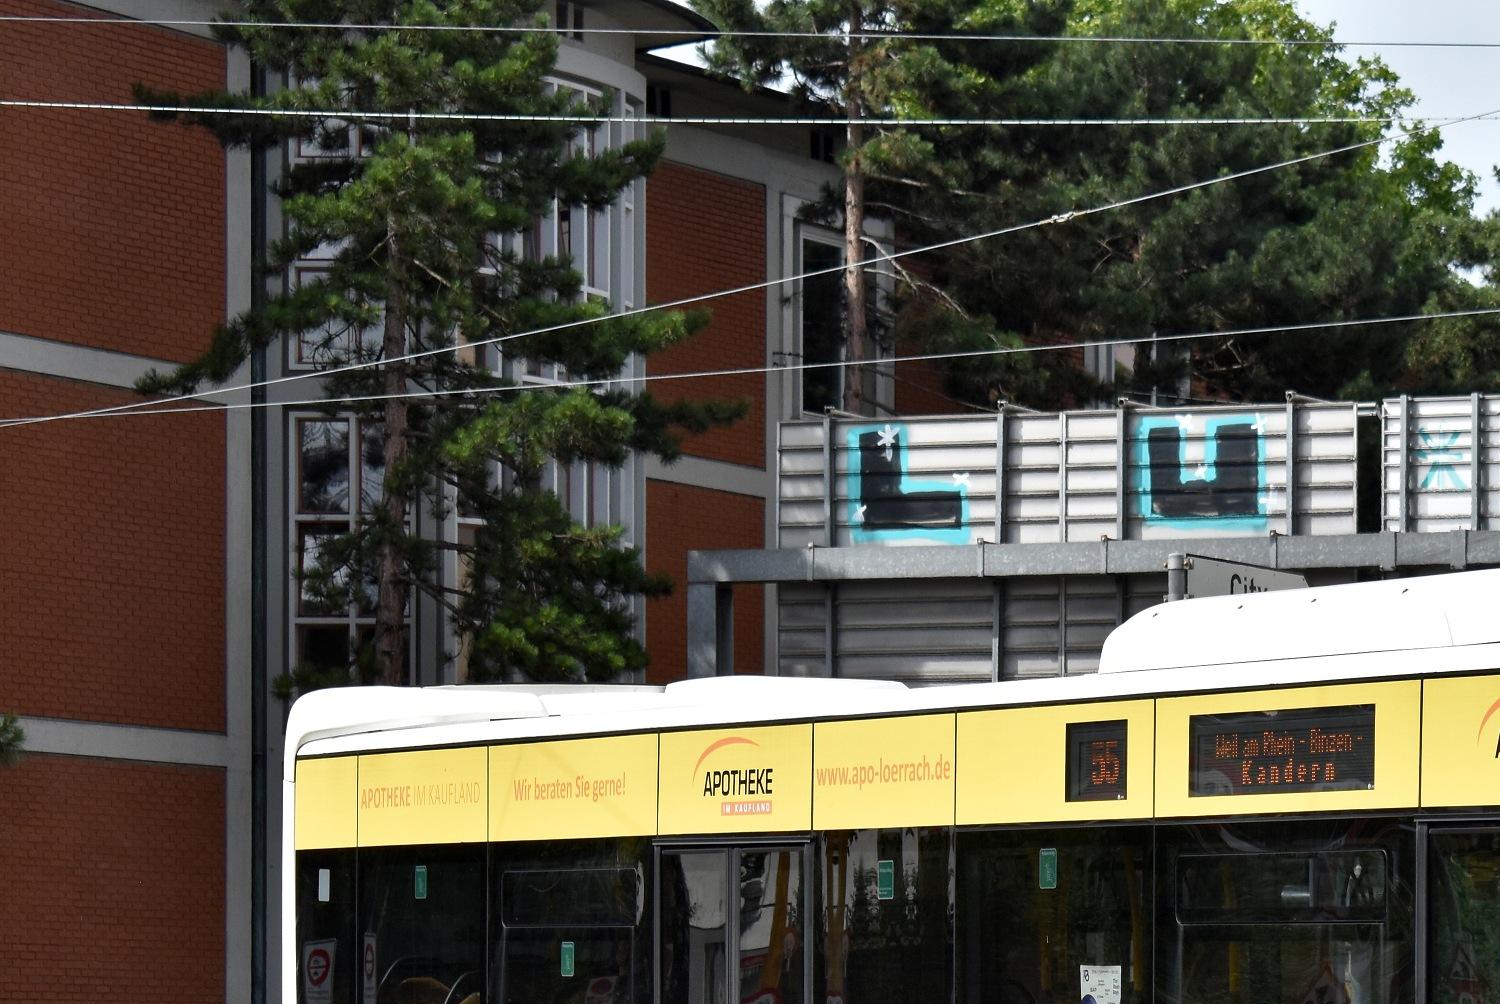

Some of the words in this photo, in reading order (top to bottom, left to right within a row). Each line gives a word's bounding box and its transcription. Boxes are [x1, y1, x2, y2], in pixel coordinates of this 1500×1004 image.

[1230, 574, 1268, 595] Cit
[1264, 730, 1294, 756] Rhein
[703, 768, 774, 797] APOTHEKE
[816, 754, 951, 791] www.apo-loerrach.de
[1242, 758, 1335, 785] Kandern
[361, 784, 412, 809] APOTHEKE
[413, 783, 427, 807] IM
[428, 781, 481, 806] KAUFLAND
[513, 777, 532, 801] Wir
[534, 774, 573, 801] beraten
[575, 774, 591, 797] Sie
[592, 770, 627, 803] gerne!
[722, 804, 732, 815] IM
[735, 802, 771, 814] KAUFLAND
